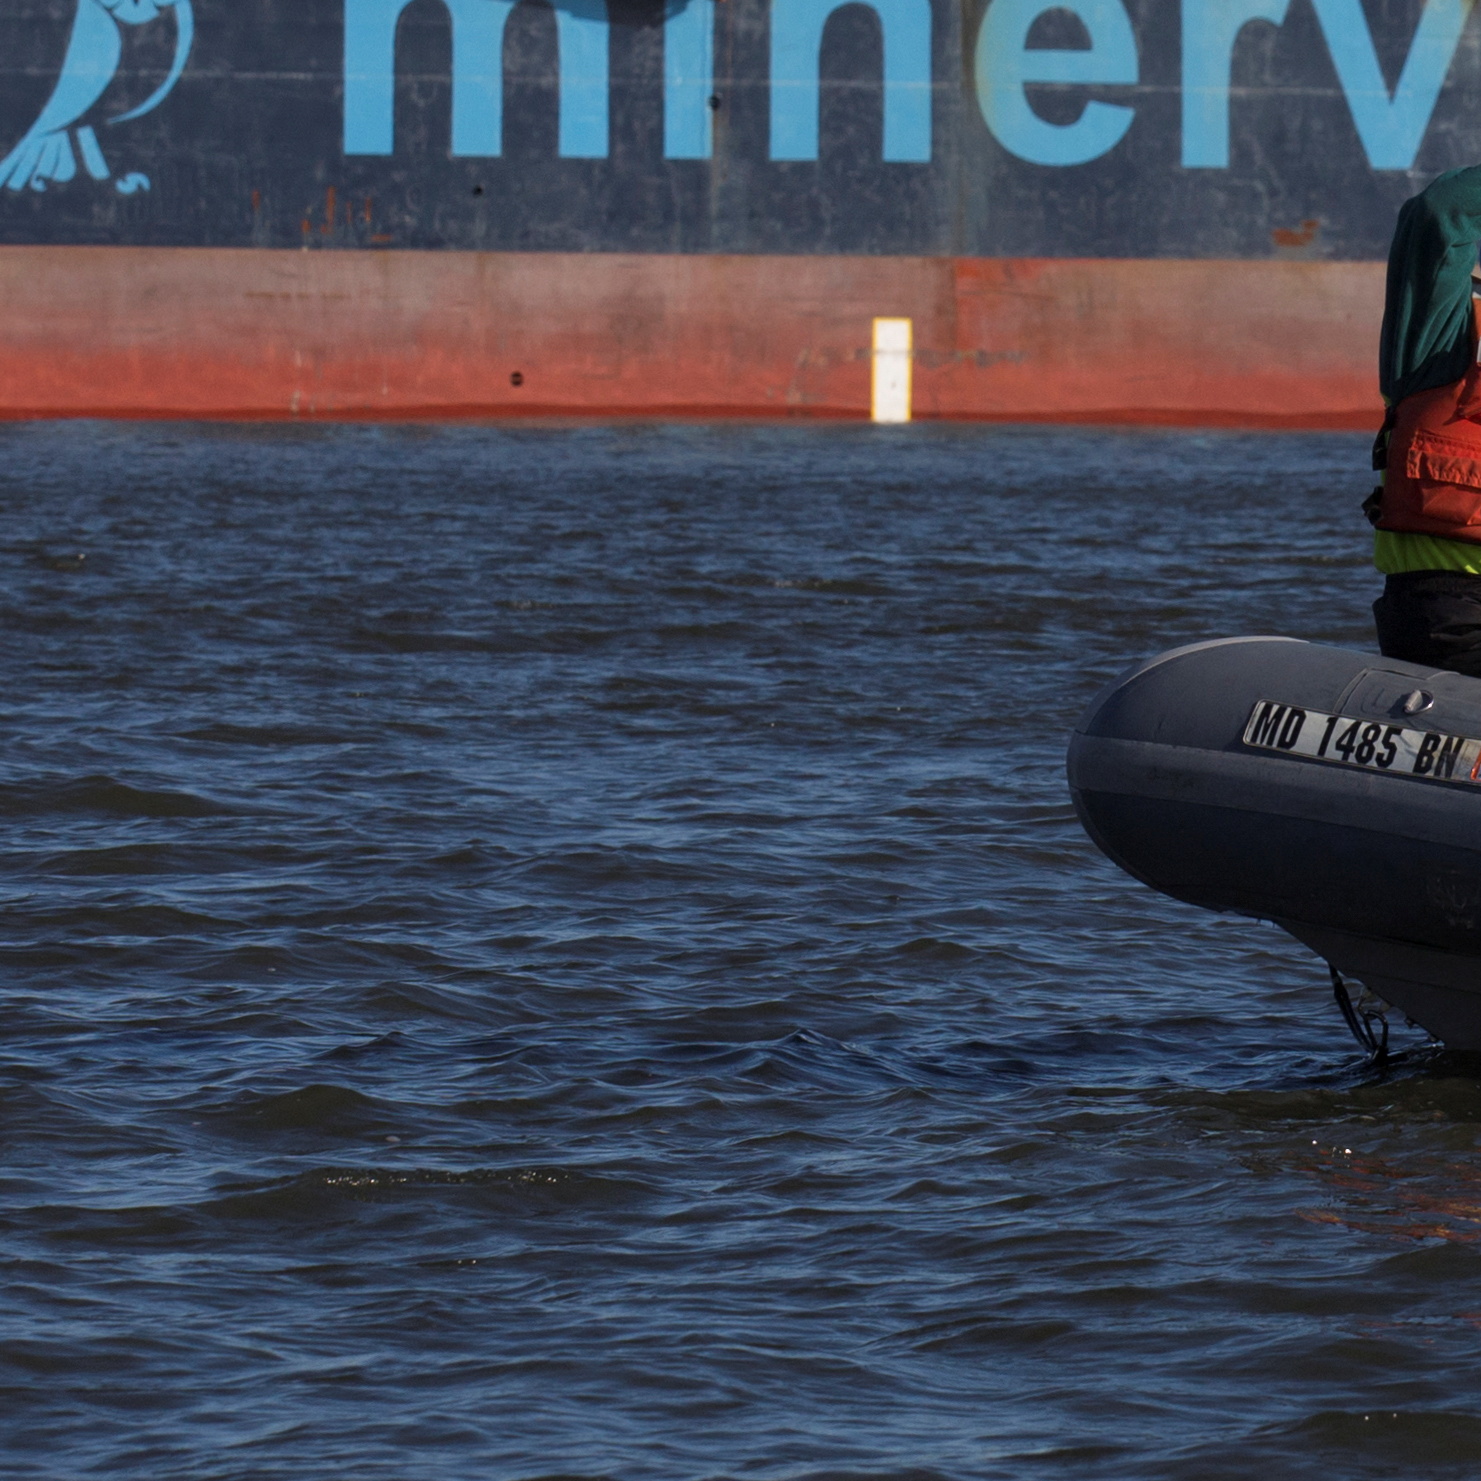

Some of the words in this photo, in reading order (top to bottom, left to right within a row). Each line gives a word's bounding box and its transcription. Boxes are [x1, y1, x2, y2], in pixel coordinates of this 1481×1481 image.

[1251, 701, 1307, 751] MD
[1317, 716, 1404, 770] 1485
[1412, 733, 1466, 779] BN
